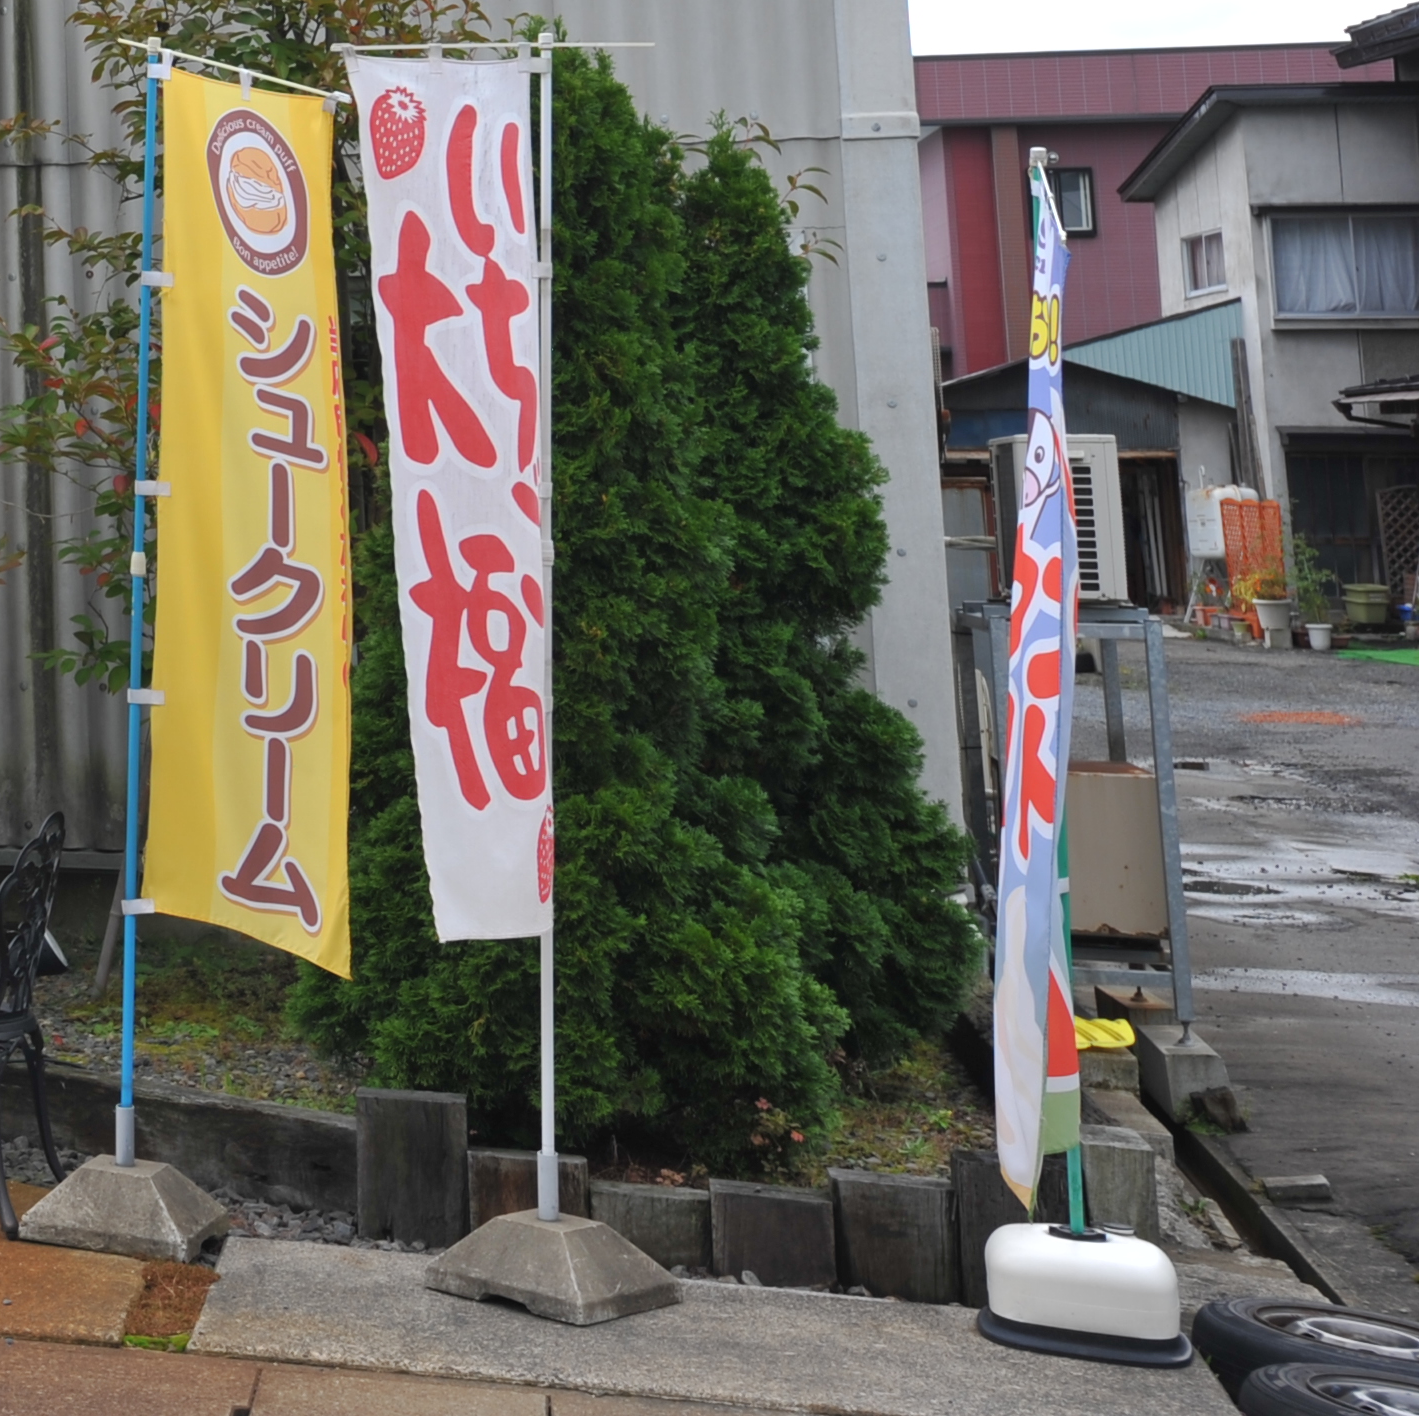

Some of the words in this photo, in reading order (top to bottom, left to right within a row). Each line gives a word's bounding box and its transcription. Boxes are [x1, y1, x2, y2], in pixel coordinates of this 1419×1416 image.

[211, 118, 245, 155] Delicious
[246, 119, 275, 146] cream
[273, 144, 297, 173] puff
[232, 235, 252, 261] Bon
[253, 245, 299, 272] appetite!
[222, 287, 327, 935] シュークリーム
[377, 210, 547, 812] 大福
